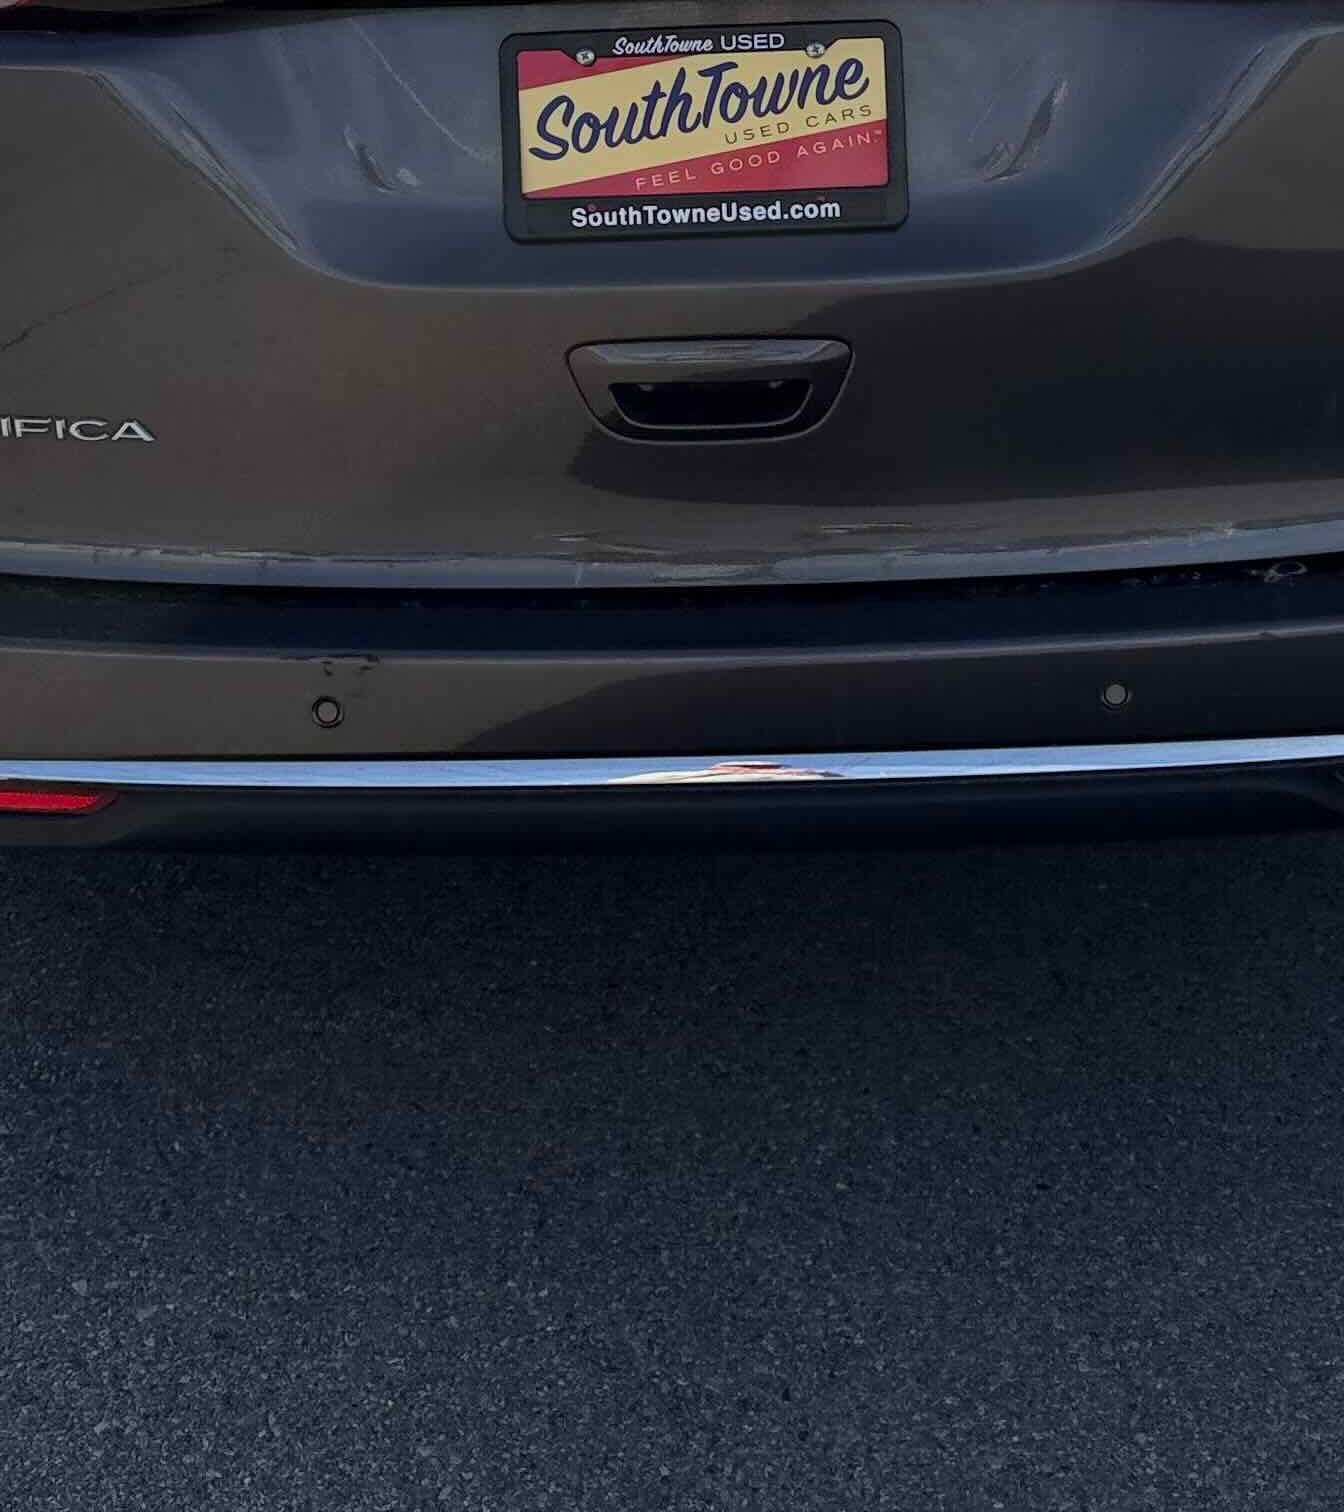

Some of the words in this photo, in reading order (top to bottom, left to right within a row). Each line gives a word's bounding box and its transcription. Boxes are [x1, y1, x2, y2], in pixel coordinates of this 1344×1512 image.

[612, 34, 713, 56] SouthTowne
[720, 33, 785, 50] USED
[528, 57, 870, 161] SouthTowne
[724, 121, 791, 145] USED
[805, 105, 873, 128] CARS
[634, 168, 697, 190] FEEL
[711, 150, 782, 175] GOOD
[571, 199, 842, 228] SouthTowneUsed.com
